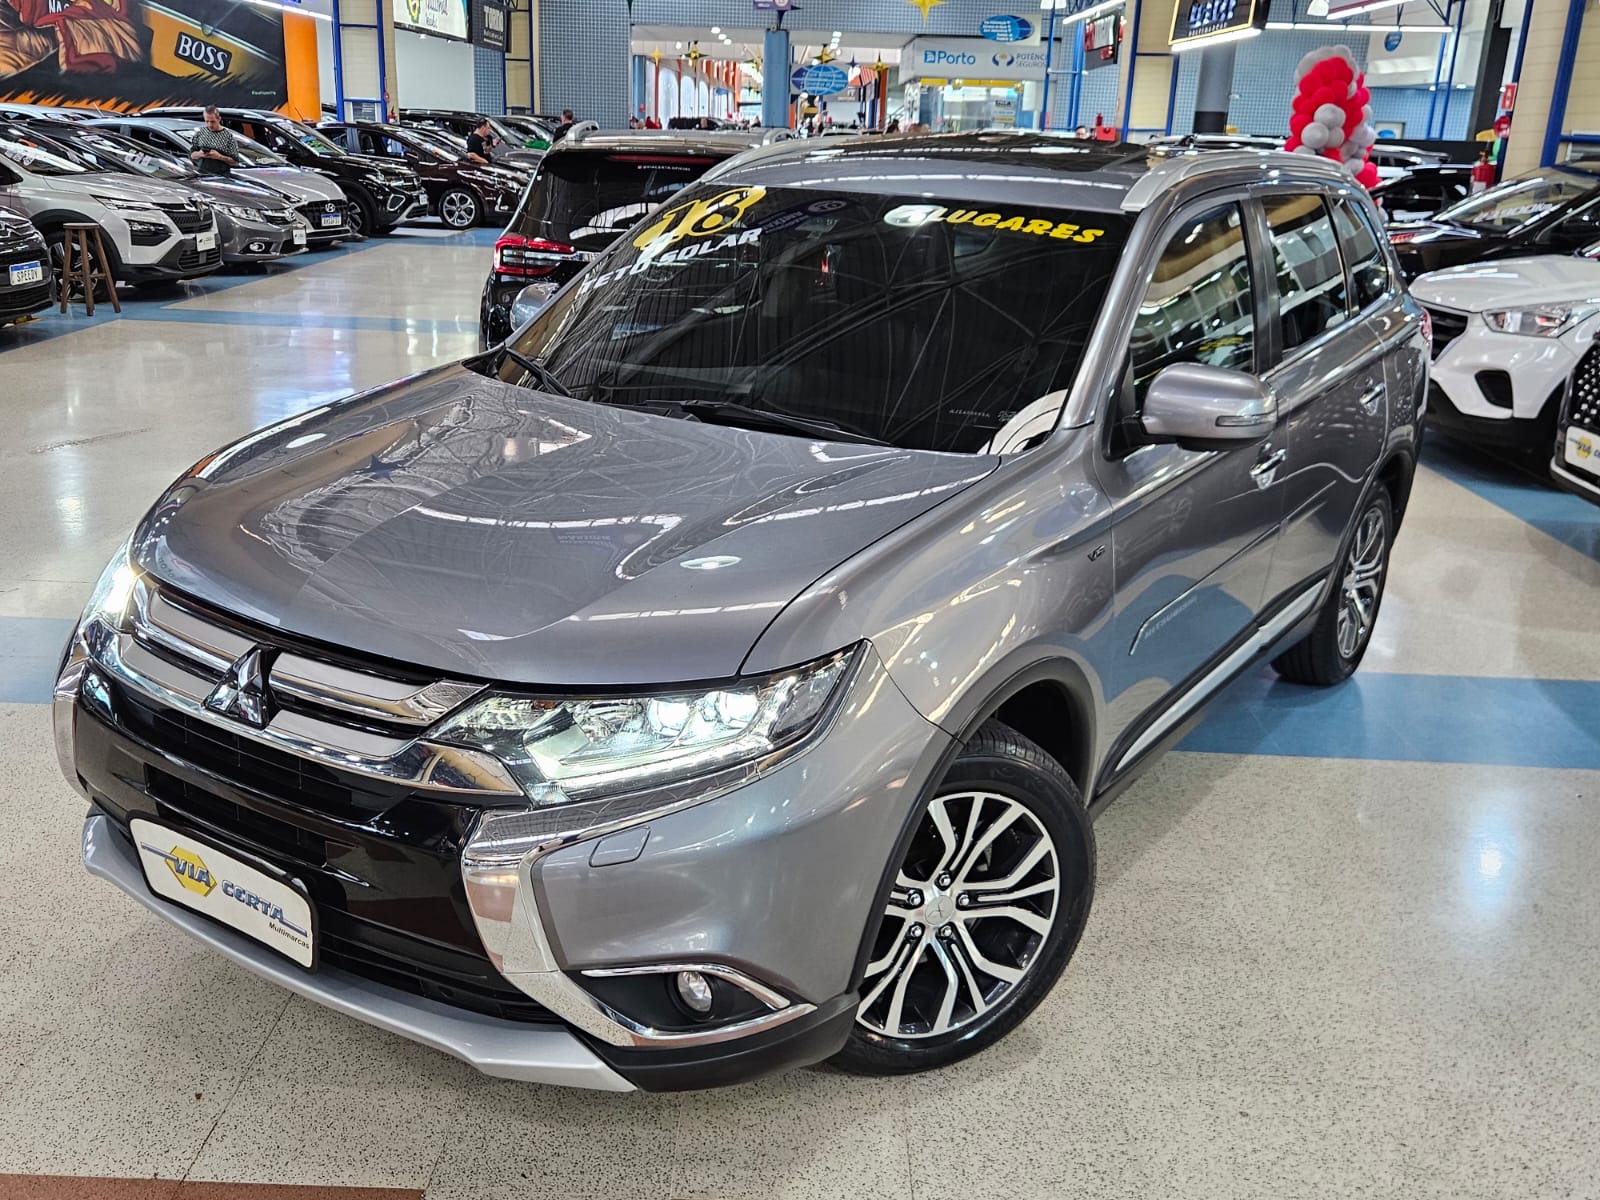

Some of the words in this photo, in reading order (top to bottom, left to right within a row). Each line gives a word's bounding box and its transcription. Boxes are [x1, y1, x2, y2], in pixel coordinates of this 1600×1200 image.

[178, 34, 228, 71] BOSS
[937, 50, 976, 65] Porto
[1016, 51, 1046, 60] POTÊNC
[926, 207, 1105, 243] LUGARES
[16, 268, 38, 281] SPEEDY
[580, 256, 651, 295] TETO
[658, 227, 763, 265] SOLAR
[174, 857, 212, 888] VIA
[222, 879, 285, 924] CERTA
[268, 921, 310, 950] Multimarcas
